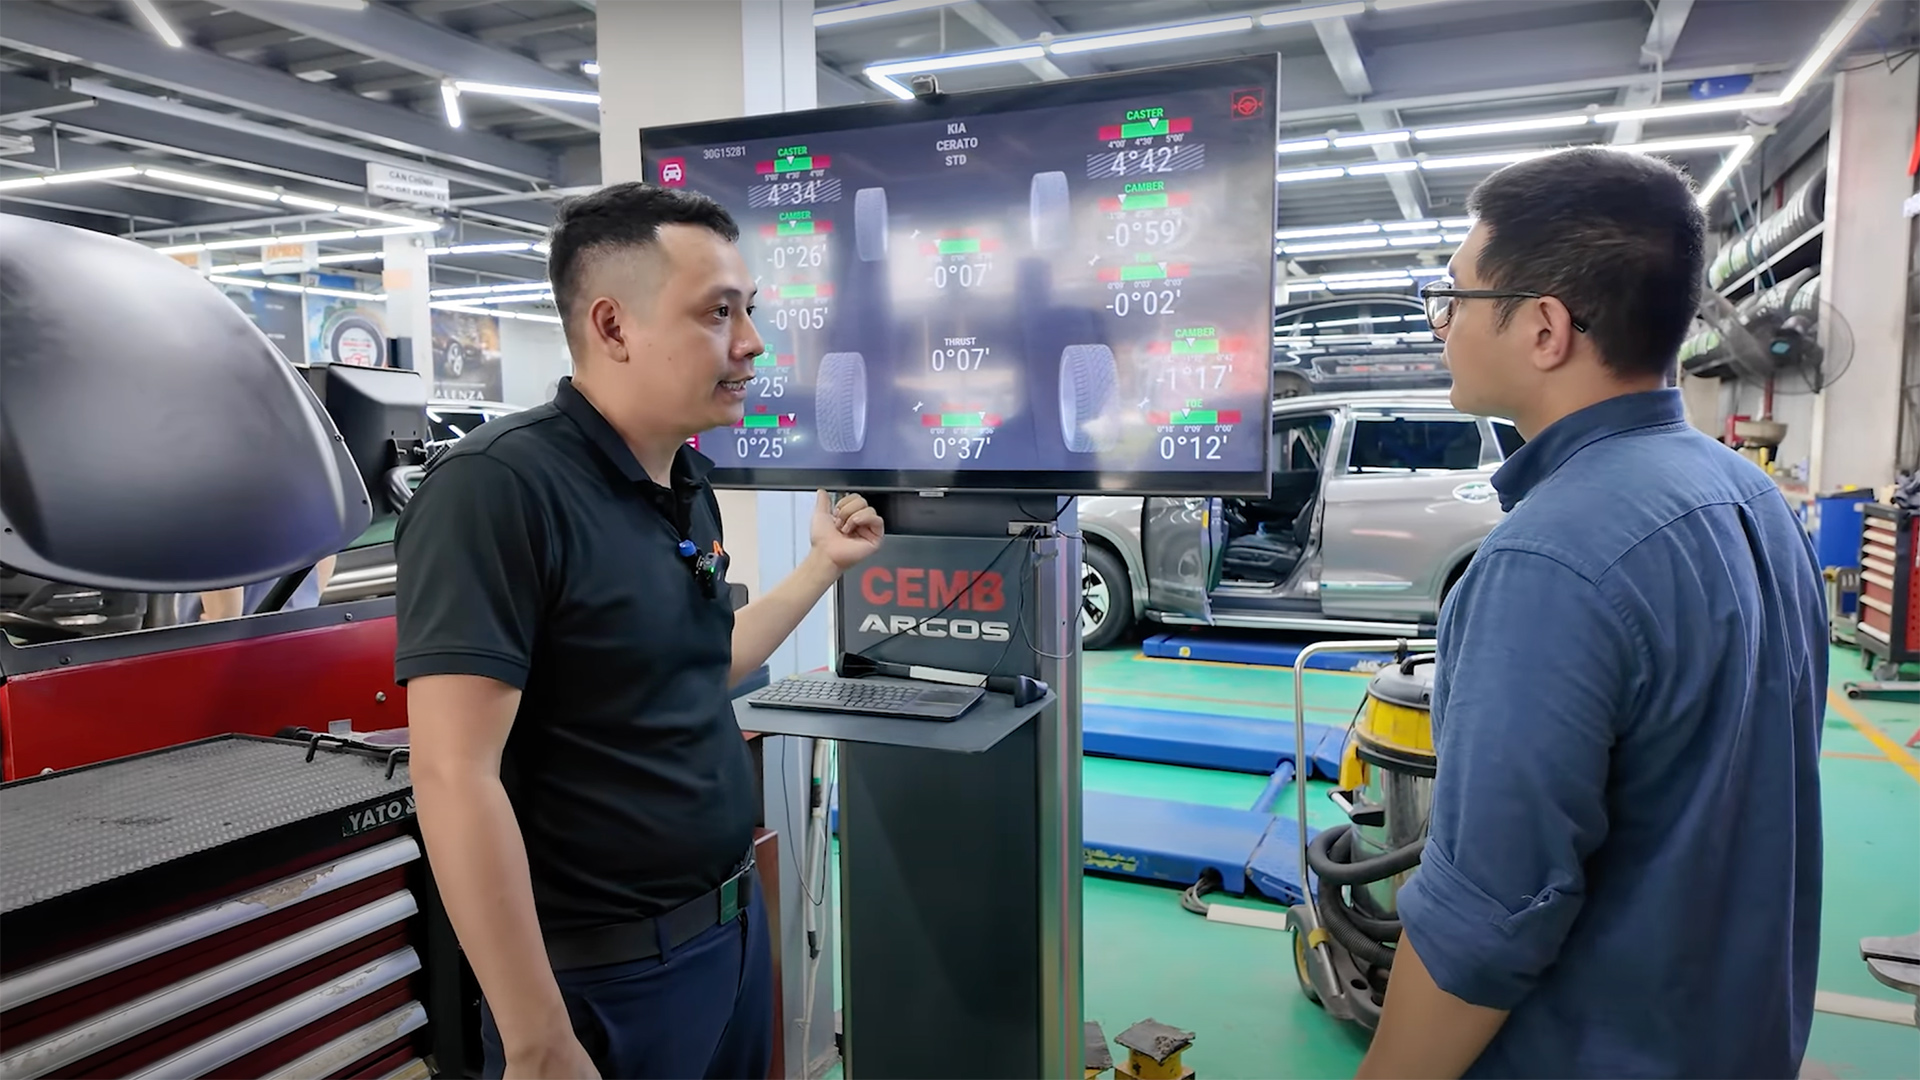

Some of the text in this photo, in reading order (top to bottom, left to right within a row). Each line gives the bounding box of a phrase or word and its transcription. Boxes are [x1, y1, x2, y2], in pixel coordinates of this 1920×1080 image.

[1126, 107, 1164, 120] CASTER
[947, 122, 967, 135] KIA
[936, 137, 979, 151] CERATO
[703, 146, 746, 160] 30G15281
[777, 146, 808, 157] CASTER
[945, 154, 967, 166] STD
[1124, 181, 1165, 193] CAMBER
[779, 211, 811, 220] CAMBER
[1174, 327, 1216, 338] CAMBER
[944, 337, 977, 346] THRUST
[932, 347, 990, 372] 0°07'
[435, 389, 485, 400] ALENZA
[737, 437, 788, 458] 0°25'
[933, 437, 991, 459] 0°37'
[1160, 435, 1228, 460] 0°12'
[860, 566, 1006, 612] CEMB
[858, 613, 1010, 642] ARCOS
[348, 800, 403, 831] YATO
